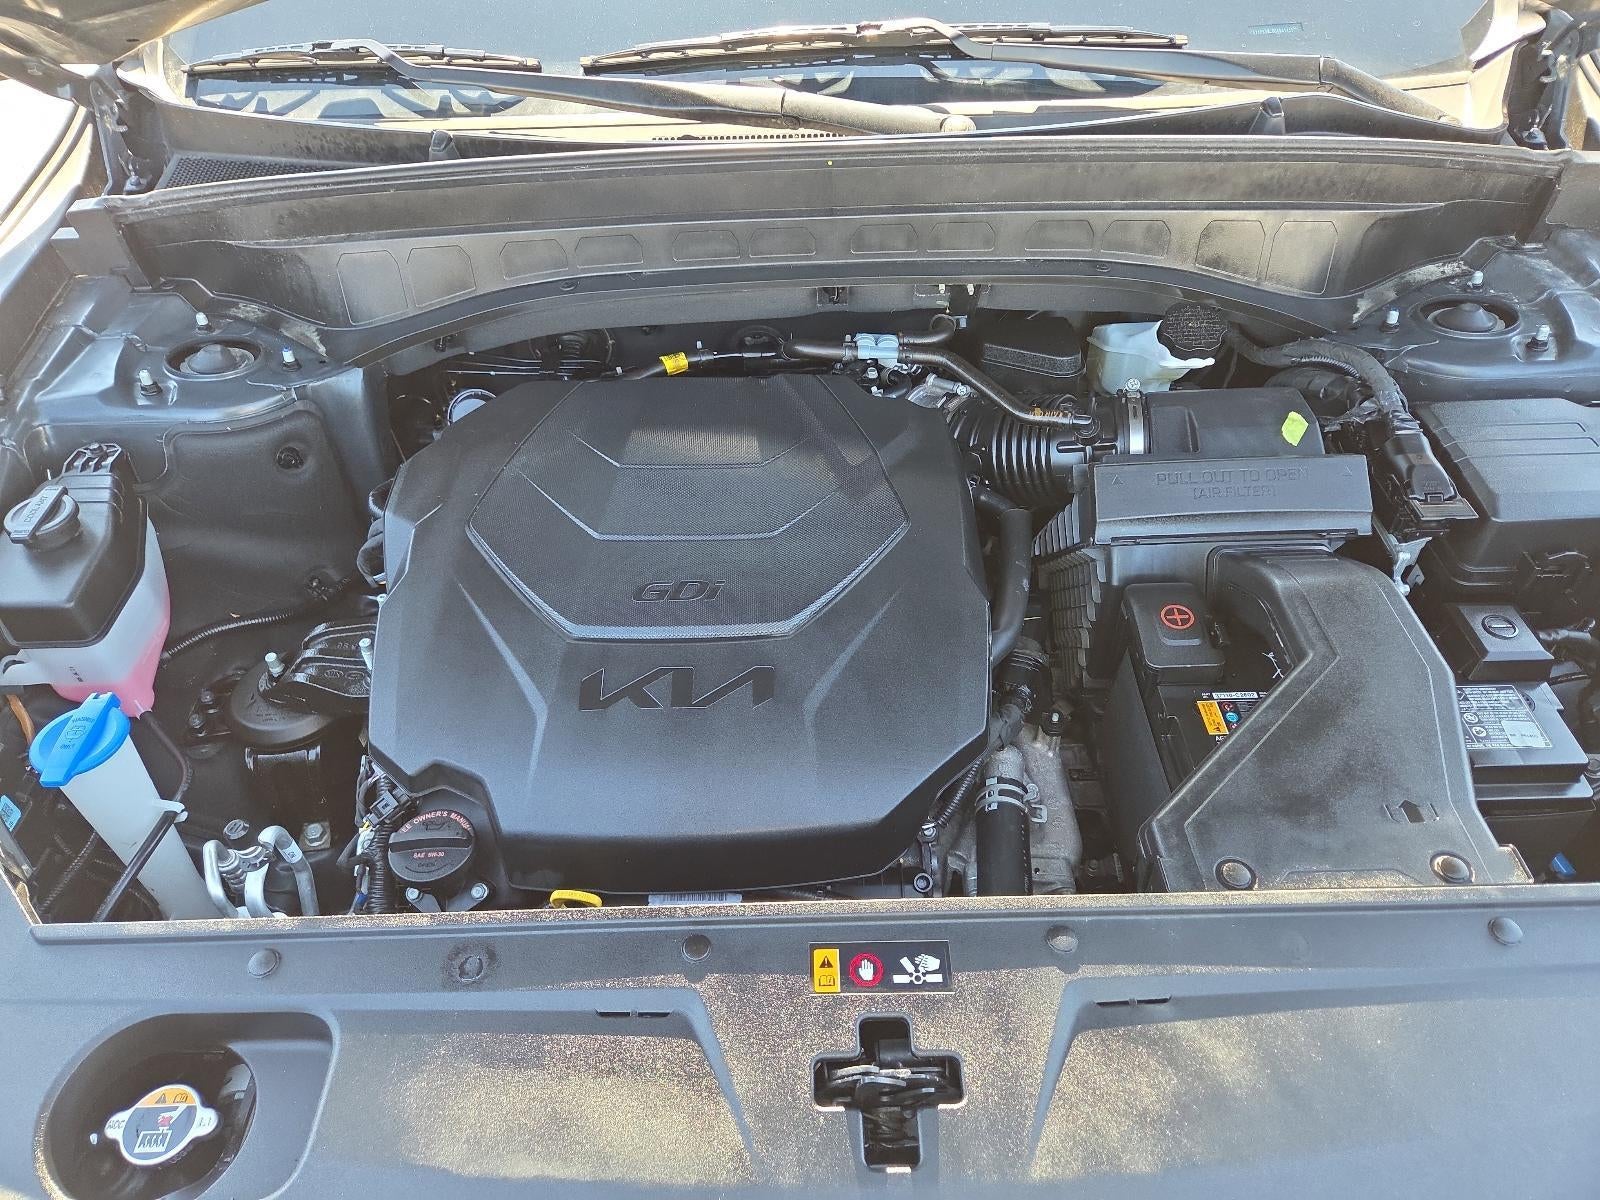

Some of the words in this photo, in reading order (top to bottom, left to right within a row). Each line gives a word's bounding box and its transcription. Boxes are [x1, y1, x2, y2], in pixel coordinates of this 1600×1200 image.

[1156, 471, 1197, 486] PULL
[1201, 470, 1233, 484] OUT
[1239, 468, 1262, 482] TO
[631, 579, 727, 603] GDi
[578, 665, 776, 712] KIA
[413, 810, 449, 824] OWNER'S
